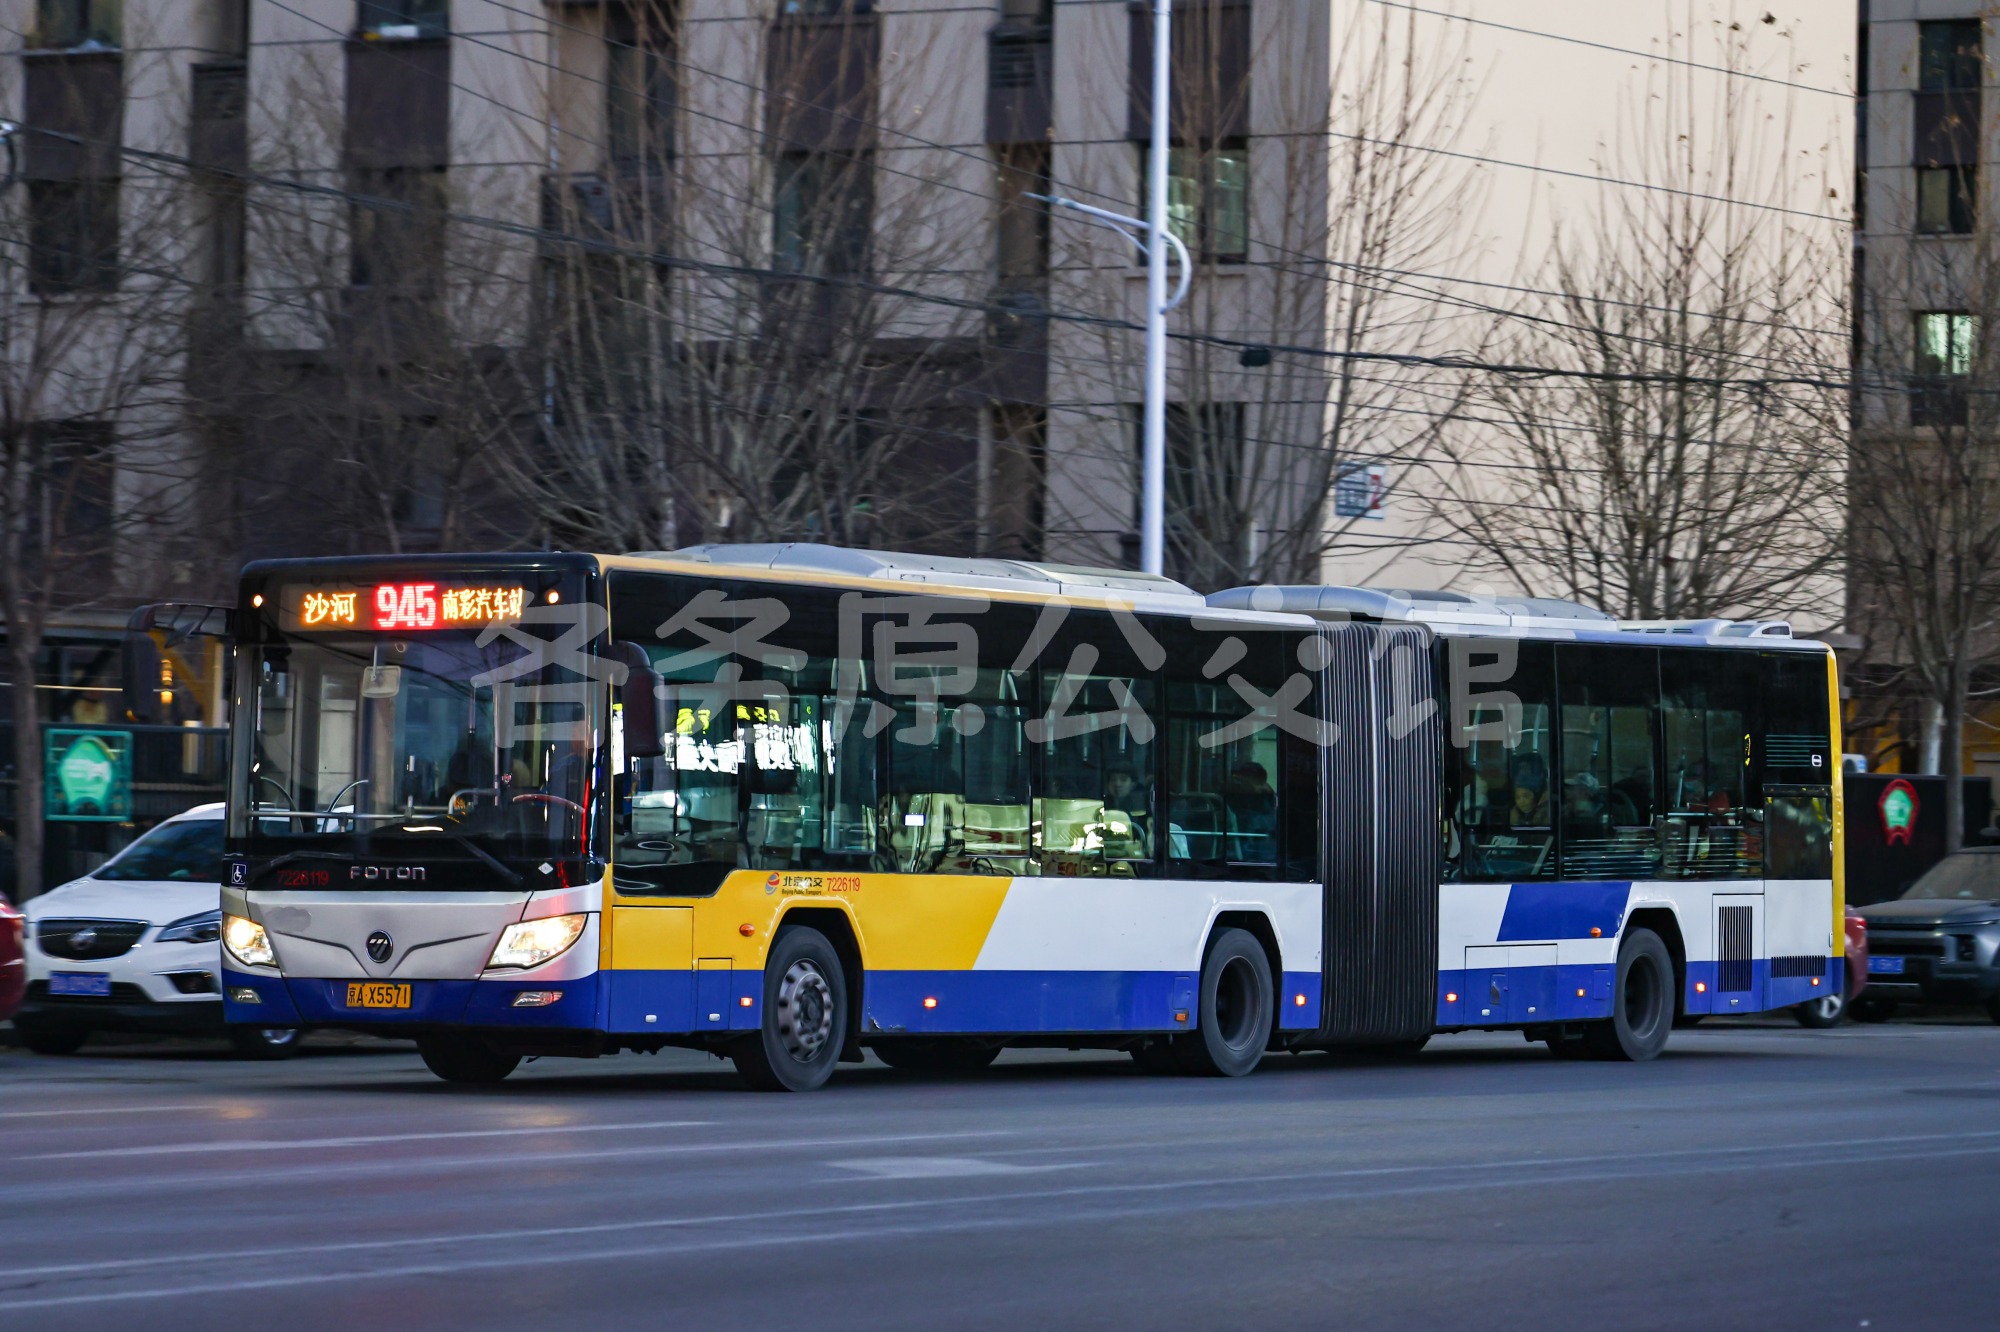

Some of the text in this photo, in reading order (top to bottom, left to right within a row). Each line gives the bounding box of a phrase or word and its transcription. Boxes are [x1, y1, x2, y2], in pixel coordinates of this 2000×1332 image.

[304, 585, 523, 627] 沙河 945 南彩汽车站
[350, 866, 426, 880] FOTON
[827, 877, 860, 892] 7226119
